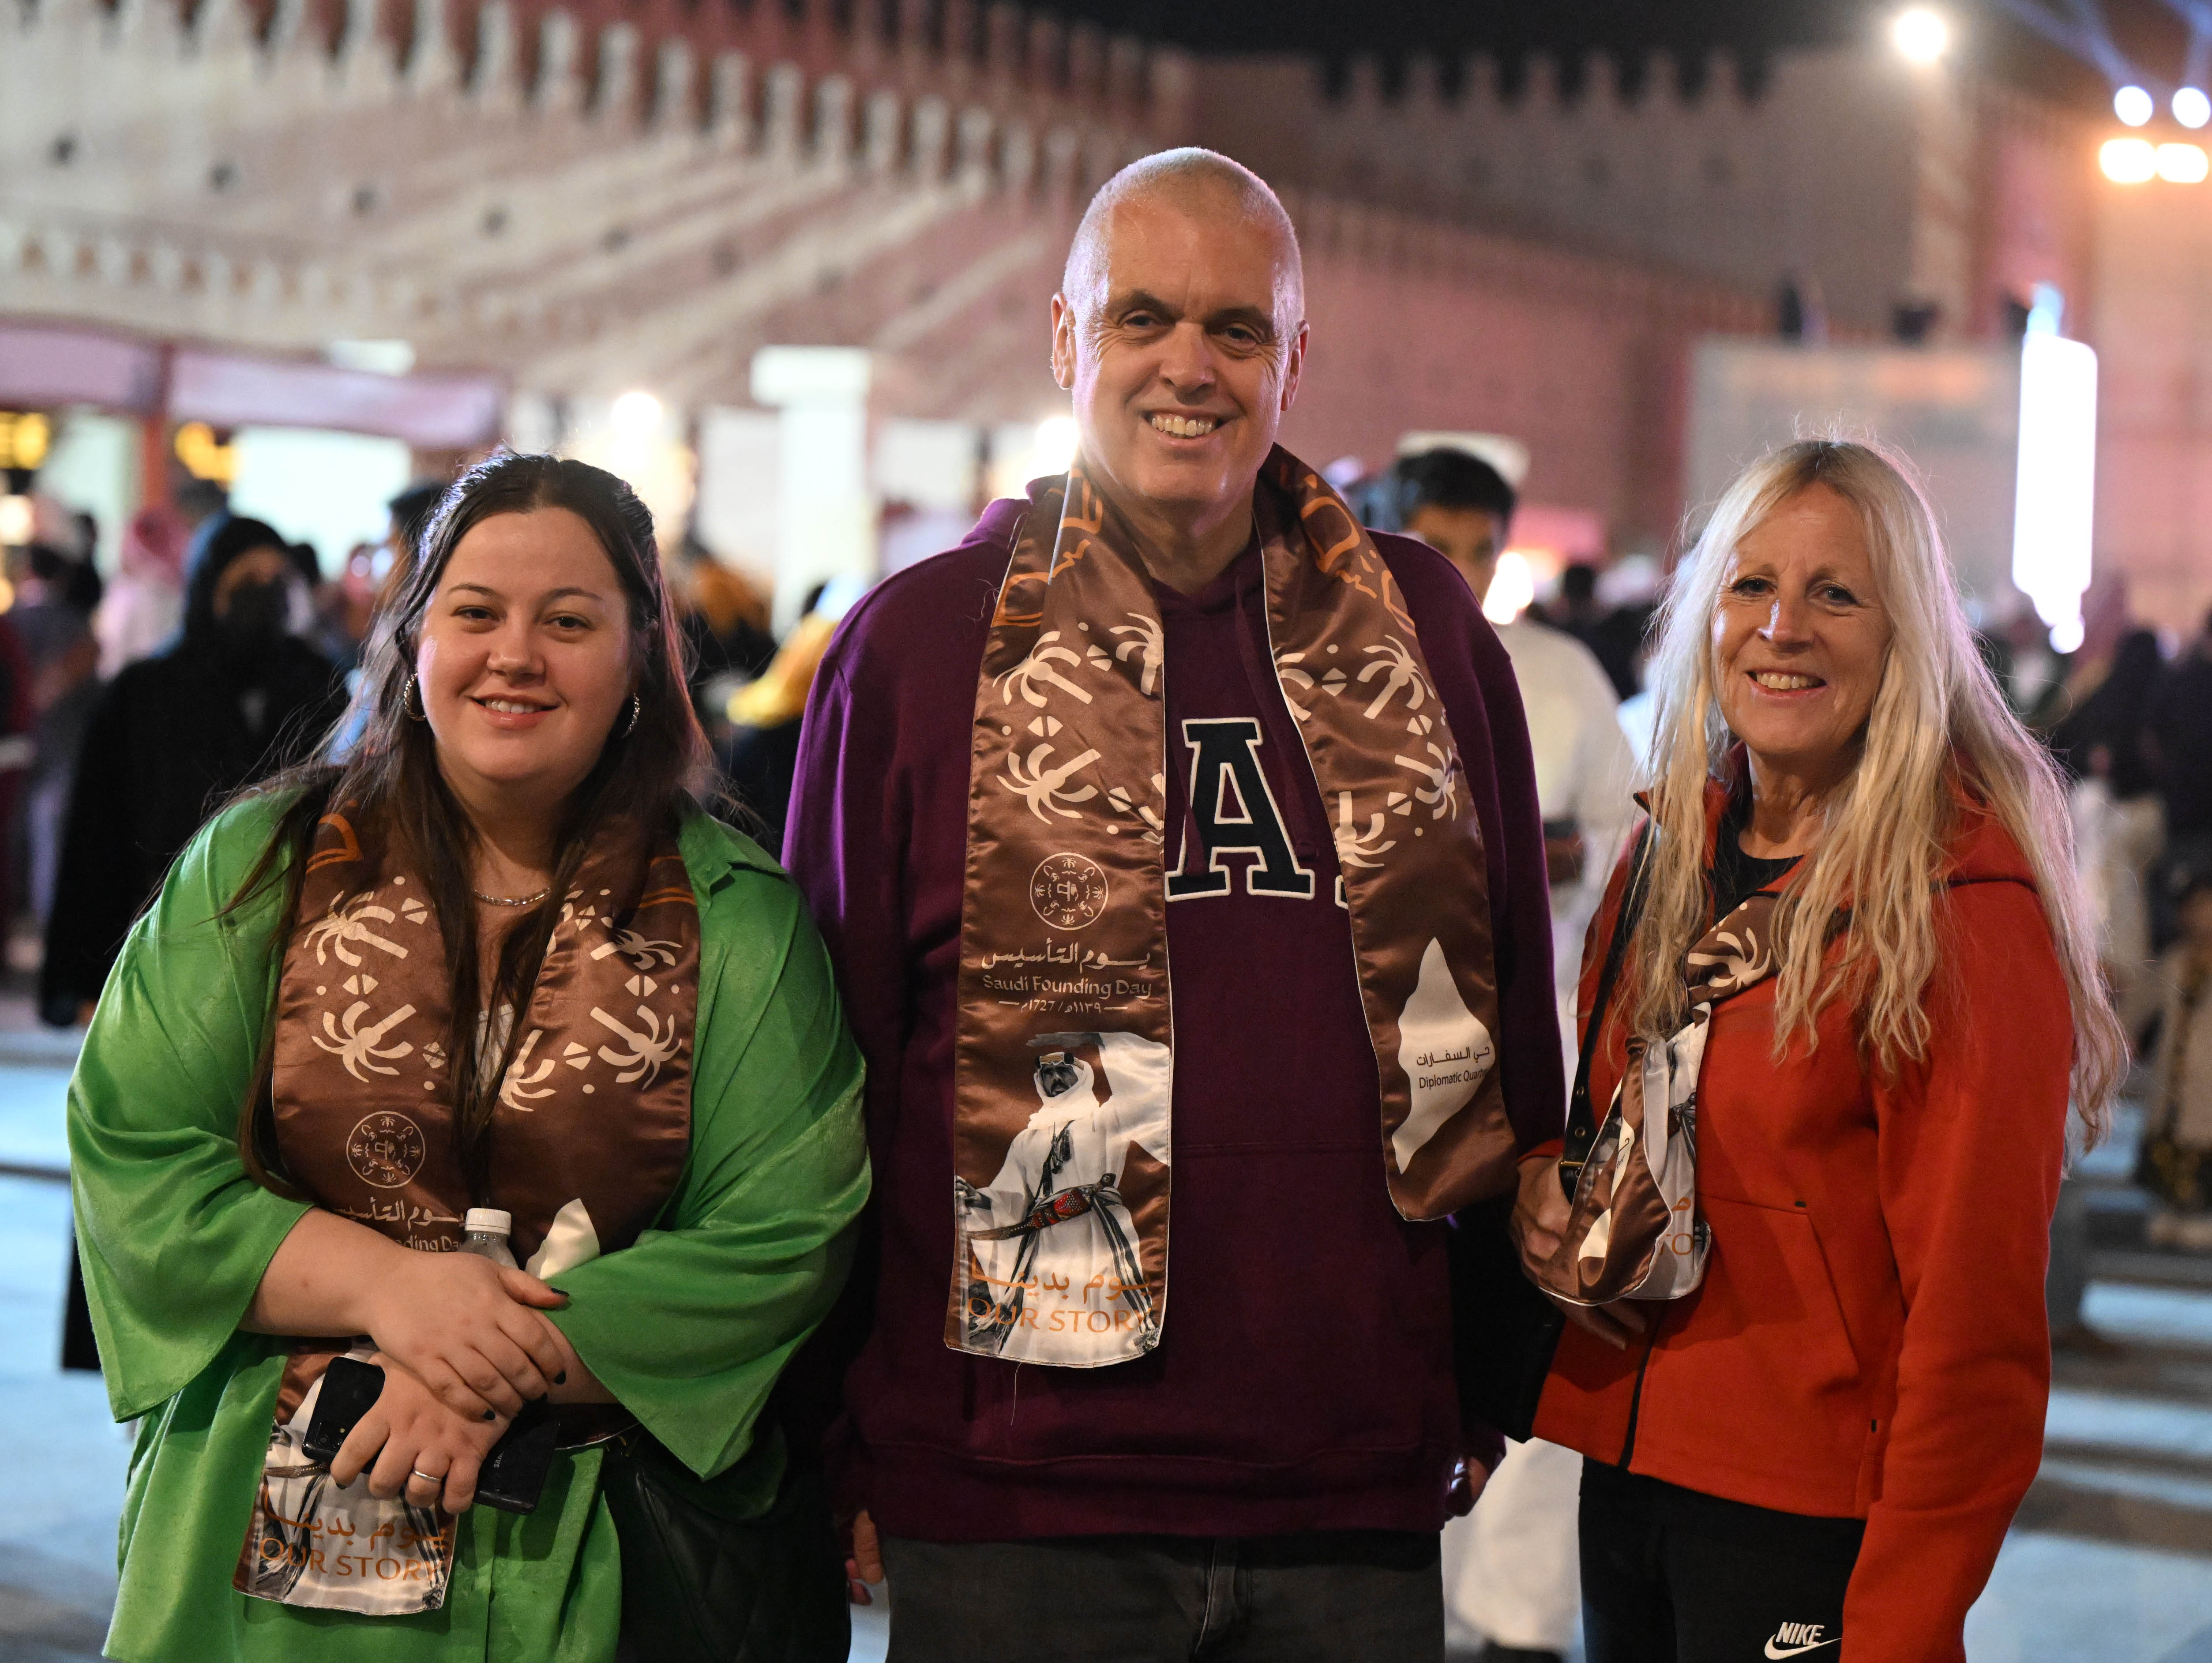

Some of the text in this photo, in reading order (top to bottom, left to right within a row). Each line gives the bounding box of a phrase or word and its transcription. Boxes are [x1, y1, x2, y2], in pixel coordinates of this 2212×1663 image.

[1165, 717, 1348, 909] A
[981, 937, 1150, 974] يوم التأسيس
[982, 975, 1152, 999] Saudi Founding Day
[1416, 1046, 1490, 1067] حي السفارات
[1419, 1068, 1489, 1090] Diplomatic Quart
[440, 1235, 463, 1252] Da
[972, 1255, 1152, 1305] يوم بدينا
[968, 1297, 1152, 1333] OUR STORY
[264, 1490, 445, 1552] يوم بدينا
[259, 1538, 443, 1581] OUR STORY
[1776, 1622, 1825, 1645] NIKE
